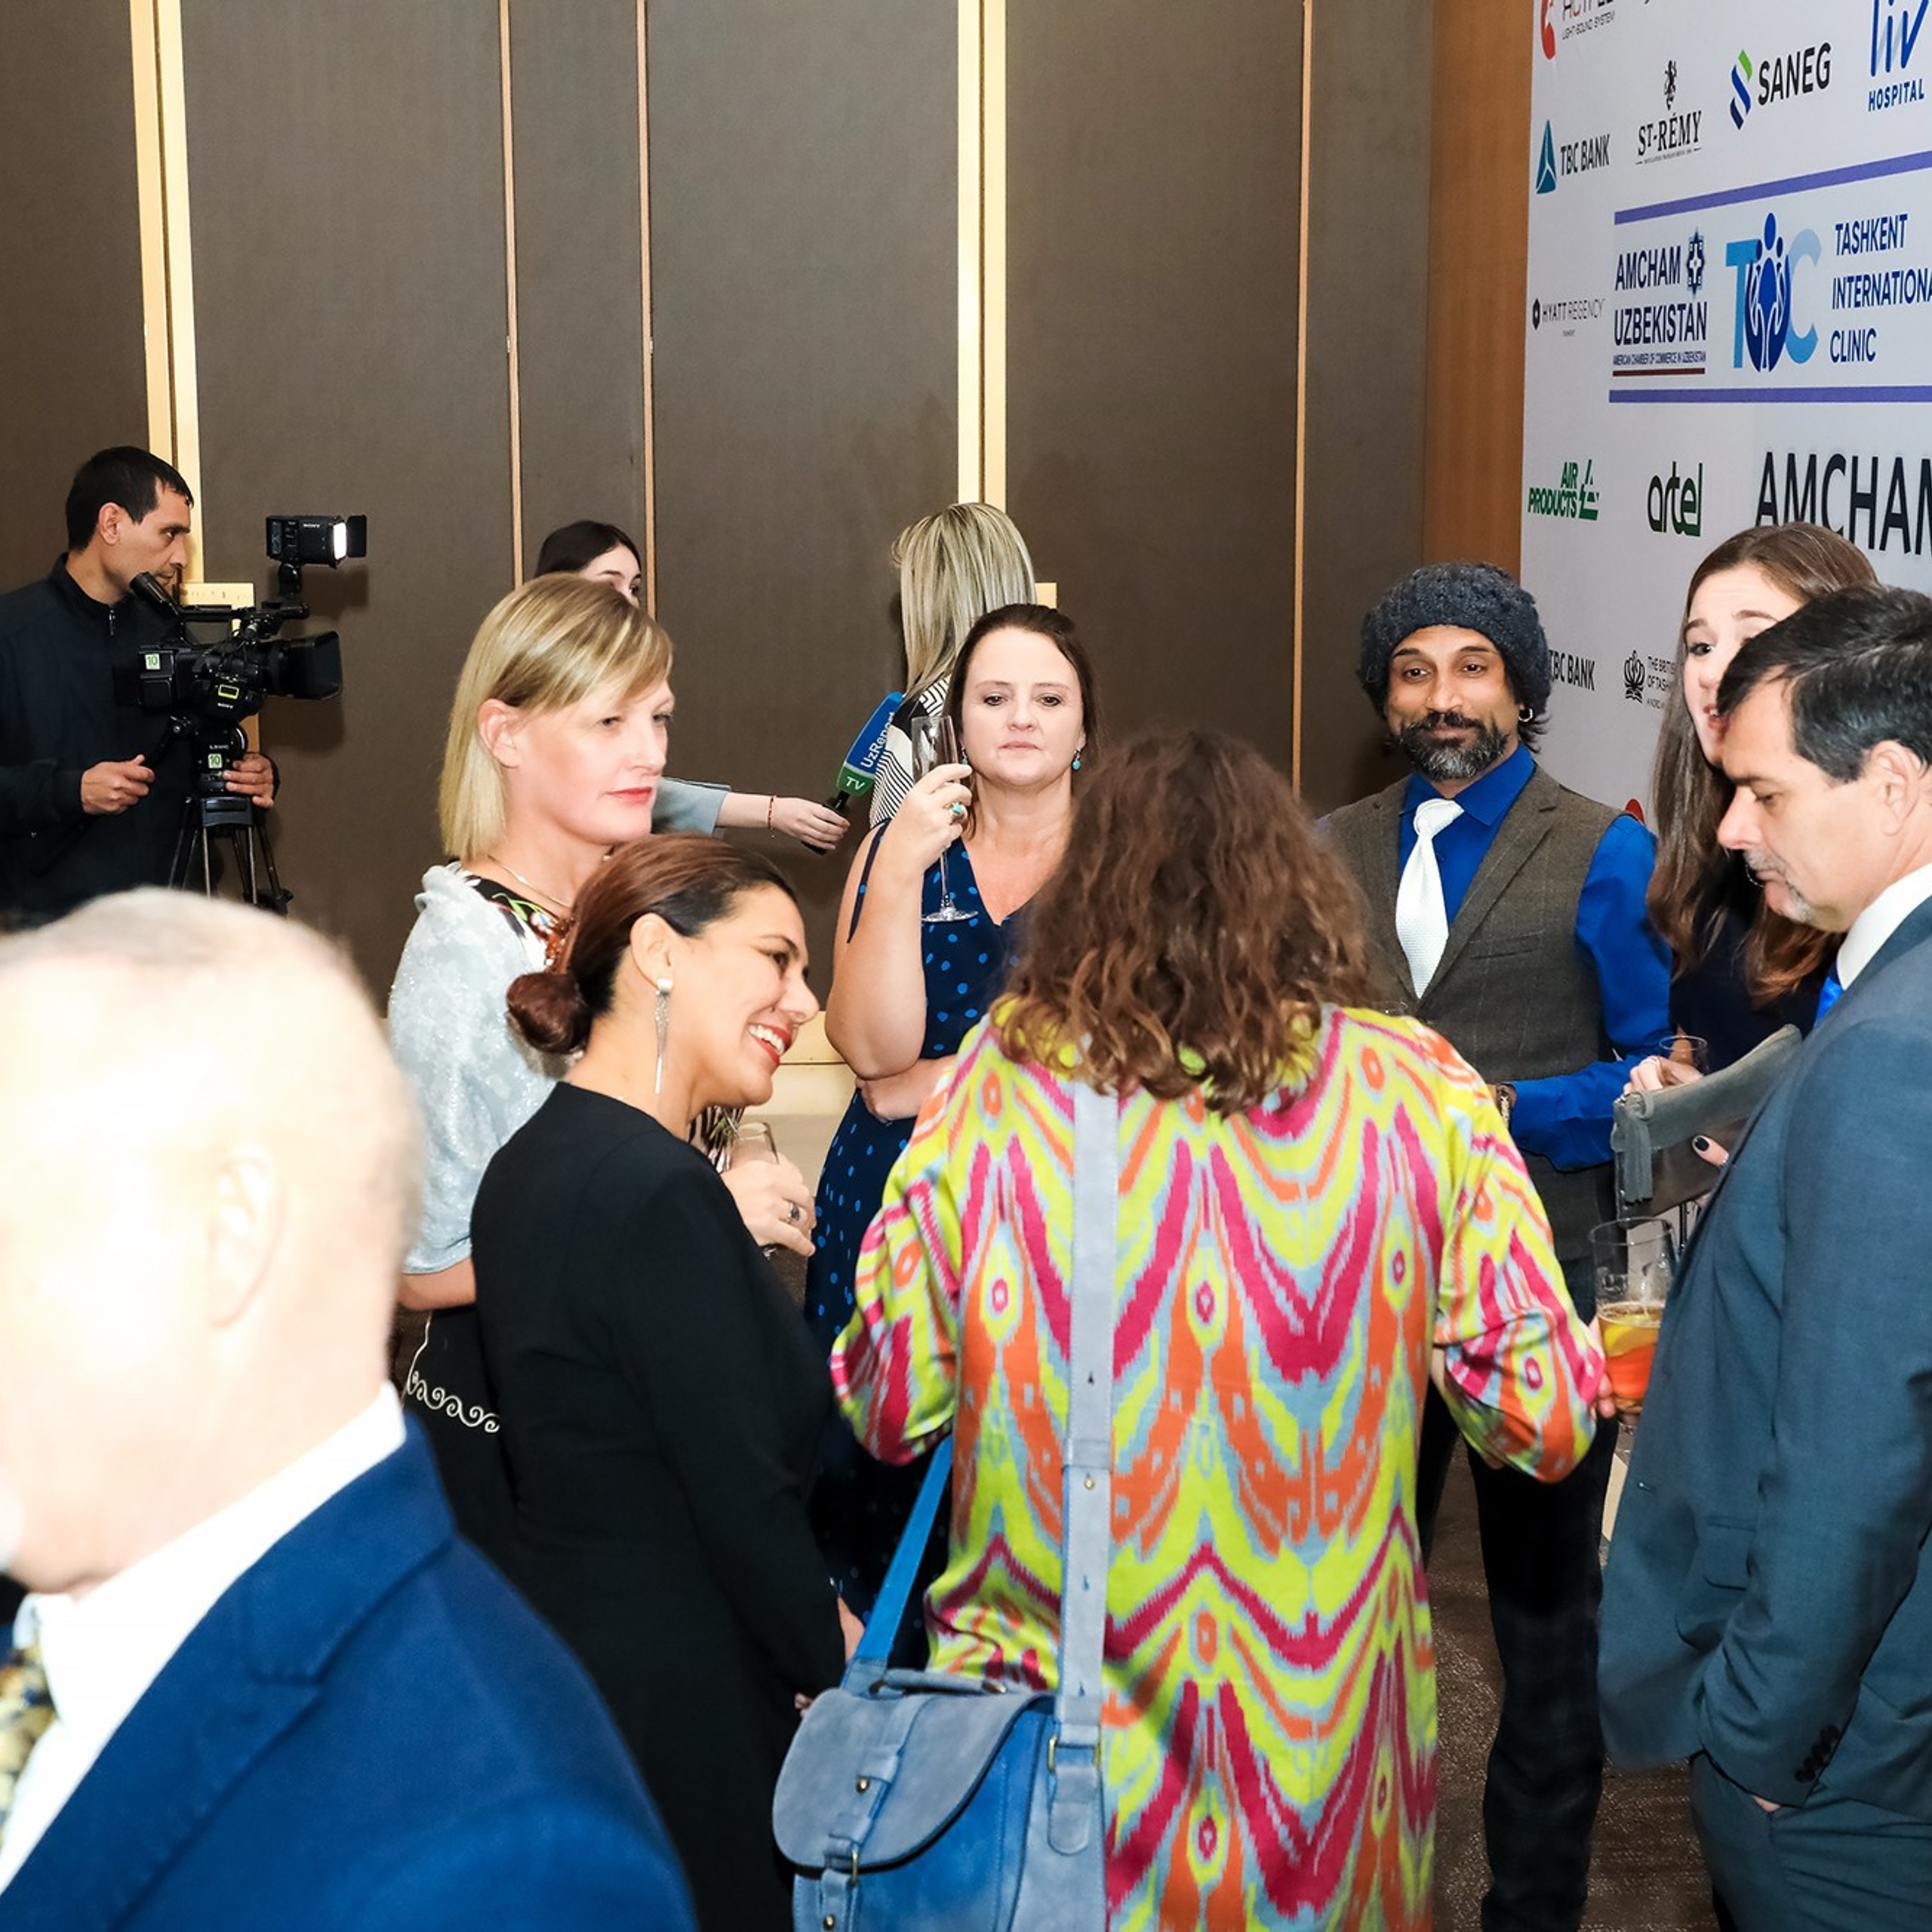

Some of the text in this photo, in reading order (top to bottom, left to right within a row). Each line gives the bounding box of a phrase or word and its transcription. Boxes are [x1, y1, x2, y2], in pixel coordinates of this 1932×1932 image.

[1758, 42, 1831, 106] SANEG
[1868, 78, 1924, 112] HOSPITAL
[1560, 134, 1611, 176] TBC BANK
[1835, 214, 1908, 256] TASHKENT
[1615, 245, 1681, 291] AMCHAM
[1542, 299, 1604, 322] HYATT REGENCY
[1614, 301, 1707, 346] UZBEKISTAN
[1830, 328, 1877, 363] CLINIC
[1561, 462, 1578, 488] AIR
[1527, 488, 1577, 518] PRODUCTS
[1647, 461, 1703, 537] artel
[147, 656, 158, 666] 10
[1549, 649, 1595, 691] TBC BANK
[210, 755, 220, 765] 10
[846, 776, 866, 791] TV
